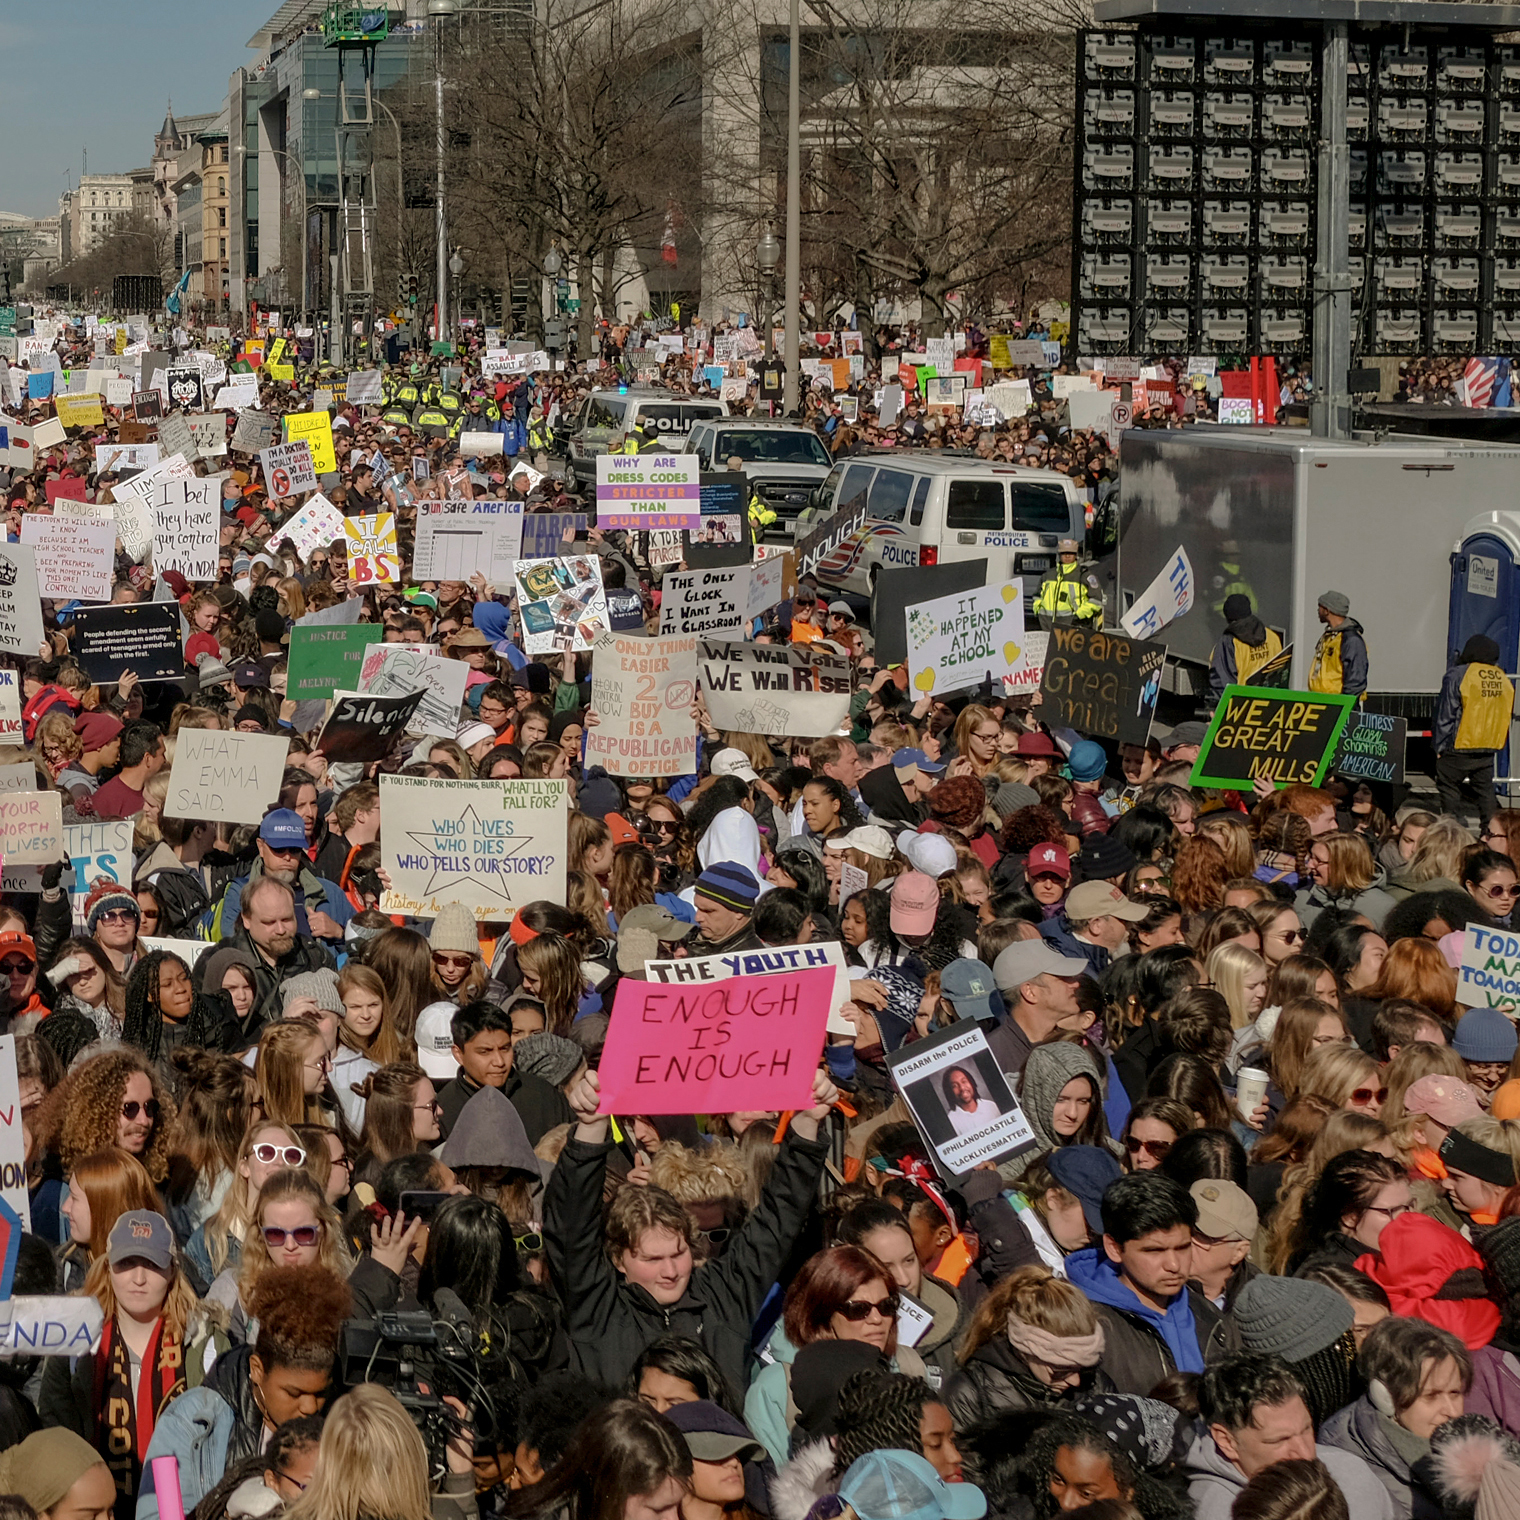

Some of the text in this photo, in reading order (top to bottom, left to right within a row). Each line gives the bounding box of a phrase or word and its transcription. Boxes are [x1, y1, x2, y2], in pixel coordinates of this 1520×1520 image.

[614, 457, 676, 468] WHY ARE
[608, 472, 688, 483] DRESS CODES
[612, 487, 685, 498] STRICTER
[630, 501, 667, 512] THAN
[360, 518, 377, 540] I
[610, 514, 688, 526] GUN LAWS
[349, 542, 393, 555] CALL
[984, 537, 1029, 546] POLICE
[882, 546, 916, 565] POLICE
[356, 555, 388, 581] BS
[671, 572, 735, 589] THE ONLY
[684, 589, 722, 603] GLOCK
[666, 602, 735, 619] I WANT IN
[958, 597, 977, 614] IT
[662, 616, 742, 634] MY CLASSROOM
[940, 608, 1003, 636] HAPPENED
[594, 632, 696, 654] THE ONLY THING
[951, 626, 992, 652] AT MY
[621, 658, 670, 672] EASIER
[940, 644, 996, 668] SCHOOL
[704, 665, 742, 691] WE
[793, 667, 849, 693] RISE
[1479, 670, 1501, 680] CSC
[637, 675, 658, 700] 2
[1481, 690, 1502, 698] STAFF
[631, 702, 662, 719] BUY
[1226, 698, 1326, 732] WE ARE
[629, 720, 662, 735] IS A
[587, 733, 695, 757] REPUBLICAN
[1214, 726, 1300, 752] GREAT
[186, 736, 245, 761] WHAT
[603, 758, 621, 772] IN
[628, 758, 680, 773] OFFICE
[1249, 757, 1318, 782] MILLS
[200, 766, 258, 787] EMMA
[432, 819, 514, 835] WHO LIVES
[435, 838, 504, 854] WHO DIES
[397, 854, 554, 875] WHO TELLS OUR STORY?
[649, 949, 827, 983] THE YOUTH
[642, 984, 800, 1023] ENOUGH
[689, 1022, 731, 1050] IS
[636, 1049, 788, 1084] ENOUGH
